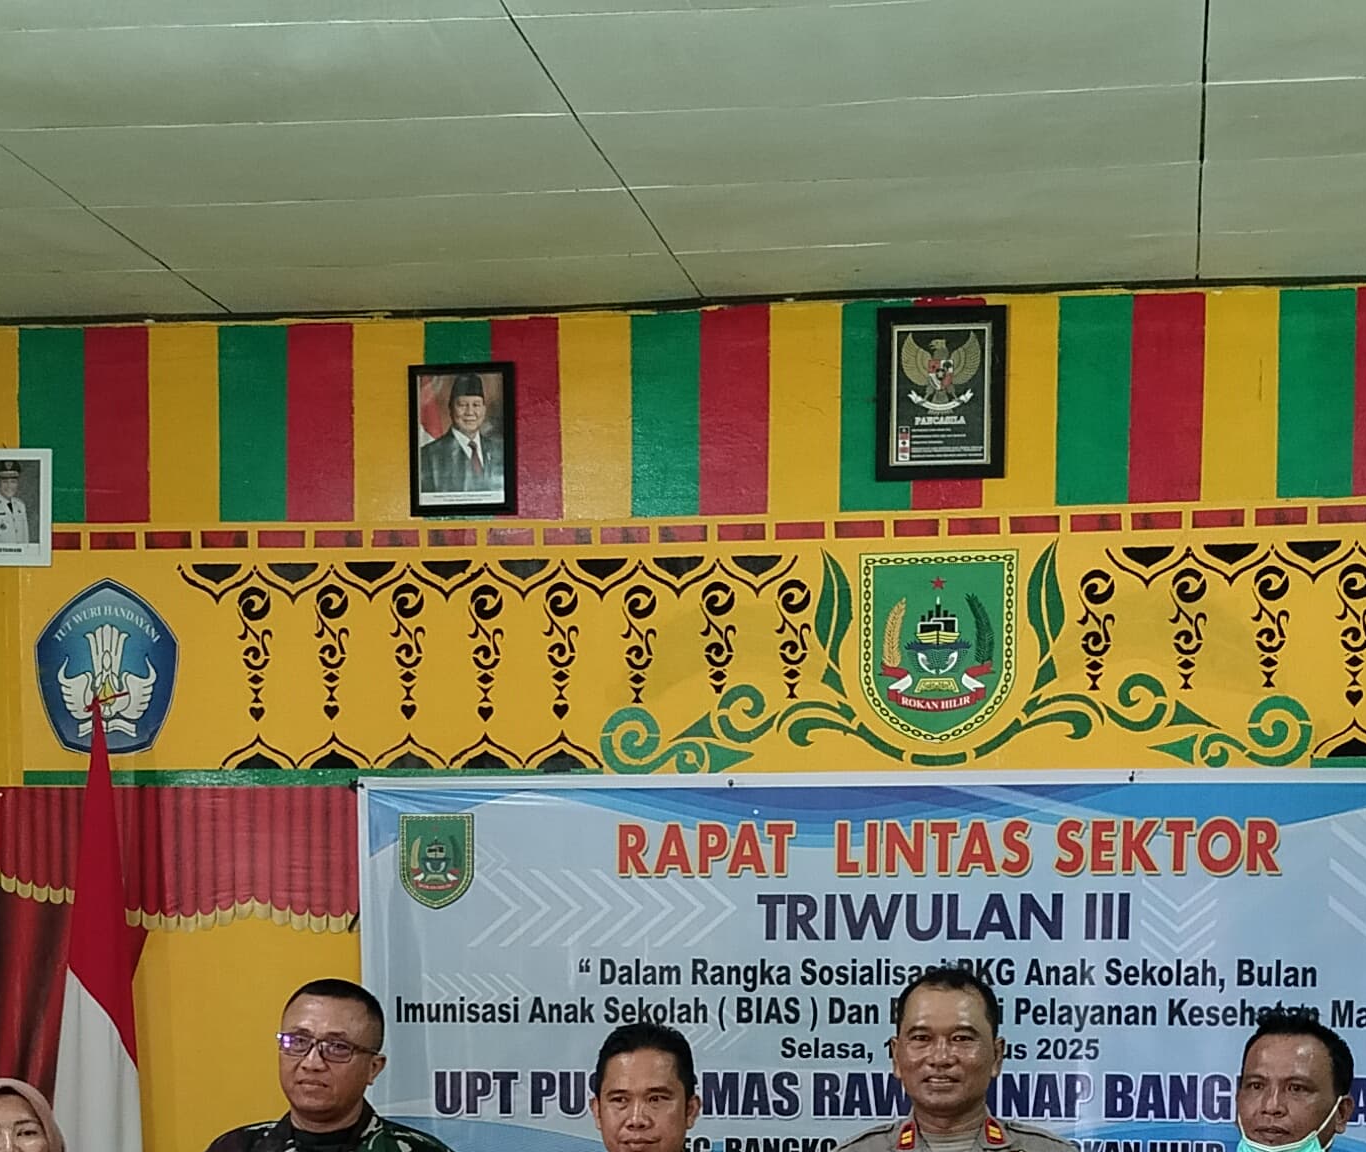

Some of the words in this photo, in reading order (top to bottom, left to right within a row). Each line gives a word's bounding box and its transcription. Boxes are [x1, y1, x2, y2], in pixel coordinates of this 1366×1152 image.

[53, 620, 73, 642] TUT
[72, 606, 102, 624] WURI
[103, 605, 161, 643] HANDAYANI
[901, 696, 938, 710] ROKAN
[940, 695, 971, 710] HILIR
[616, 821, 796, 877] RAPAT
[836, 819, 1033, 876] LINTAS
[1053, 817, 1282, 876] SEKTOR
[757, 892, 1064, 941] TRIWULAN
[1084, 892, 1131, 941] III
[599, 959, 685, 986] Dalam
[691, 959, 791, 993] Rangka
[1024, 958, 1097, 987] Anak
[1105, 958, 1226, 993] Sekolah,
[1236, 959, 1318, 988] Bulan
[395, 996, 520, 1024] Imunisasi
[529, 996, 595, 1024] Anak
[603, 996, 708, 1024] Sekolah
[736, 997, 800, 1024] BIAS
[828, 997, 880, 1025] Dan
[1014, 998, 1157, 1031] Pelayanan
[780, 1037, 874, 1064] Selasa,
[1036, 1038, 1100, 1061] 2025
[434, 1071, 519, 1116] UPT
